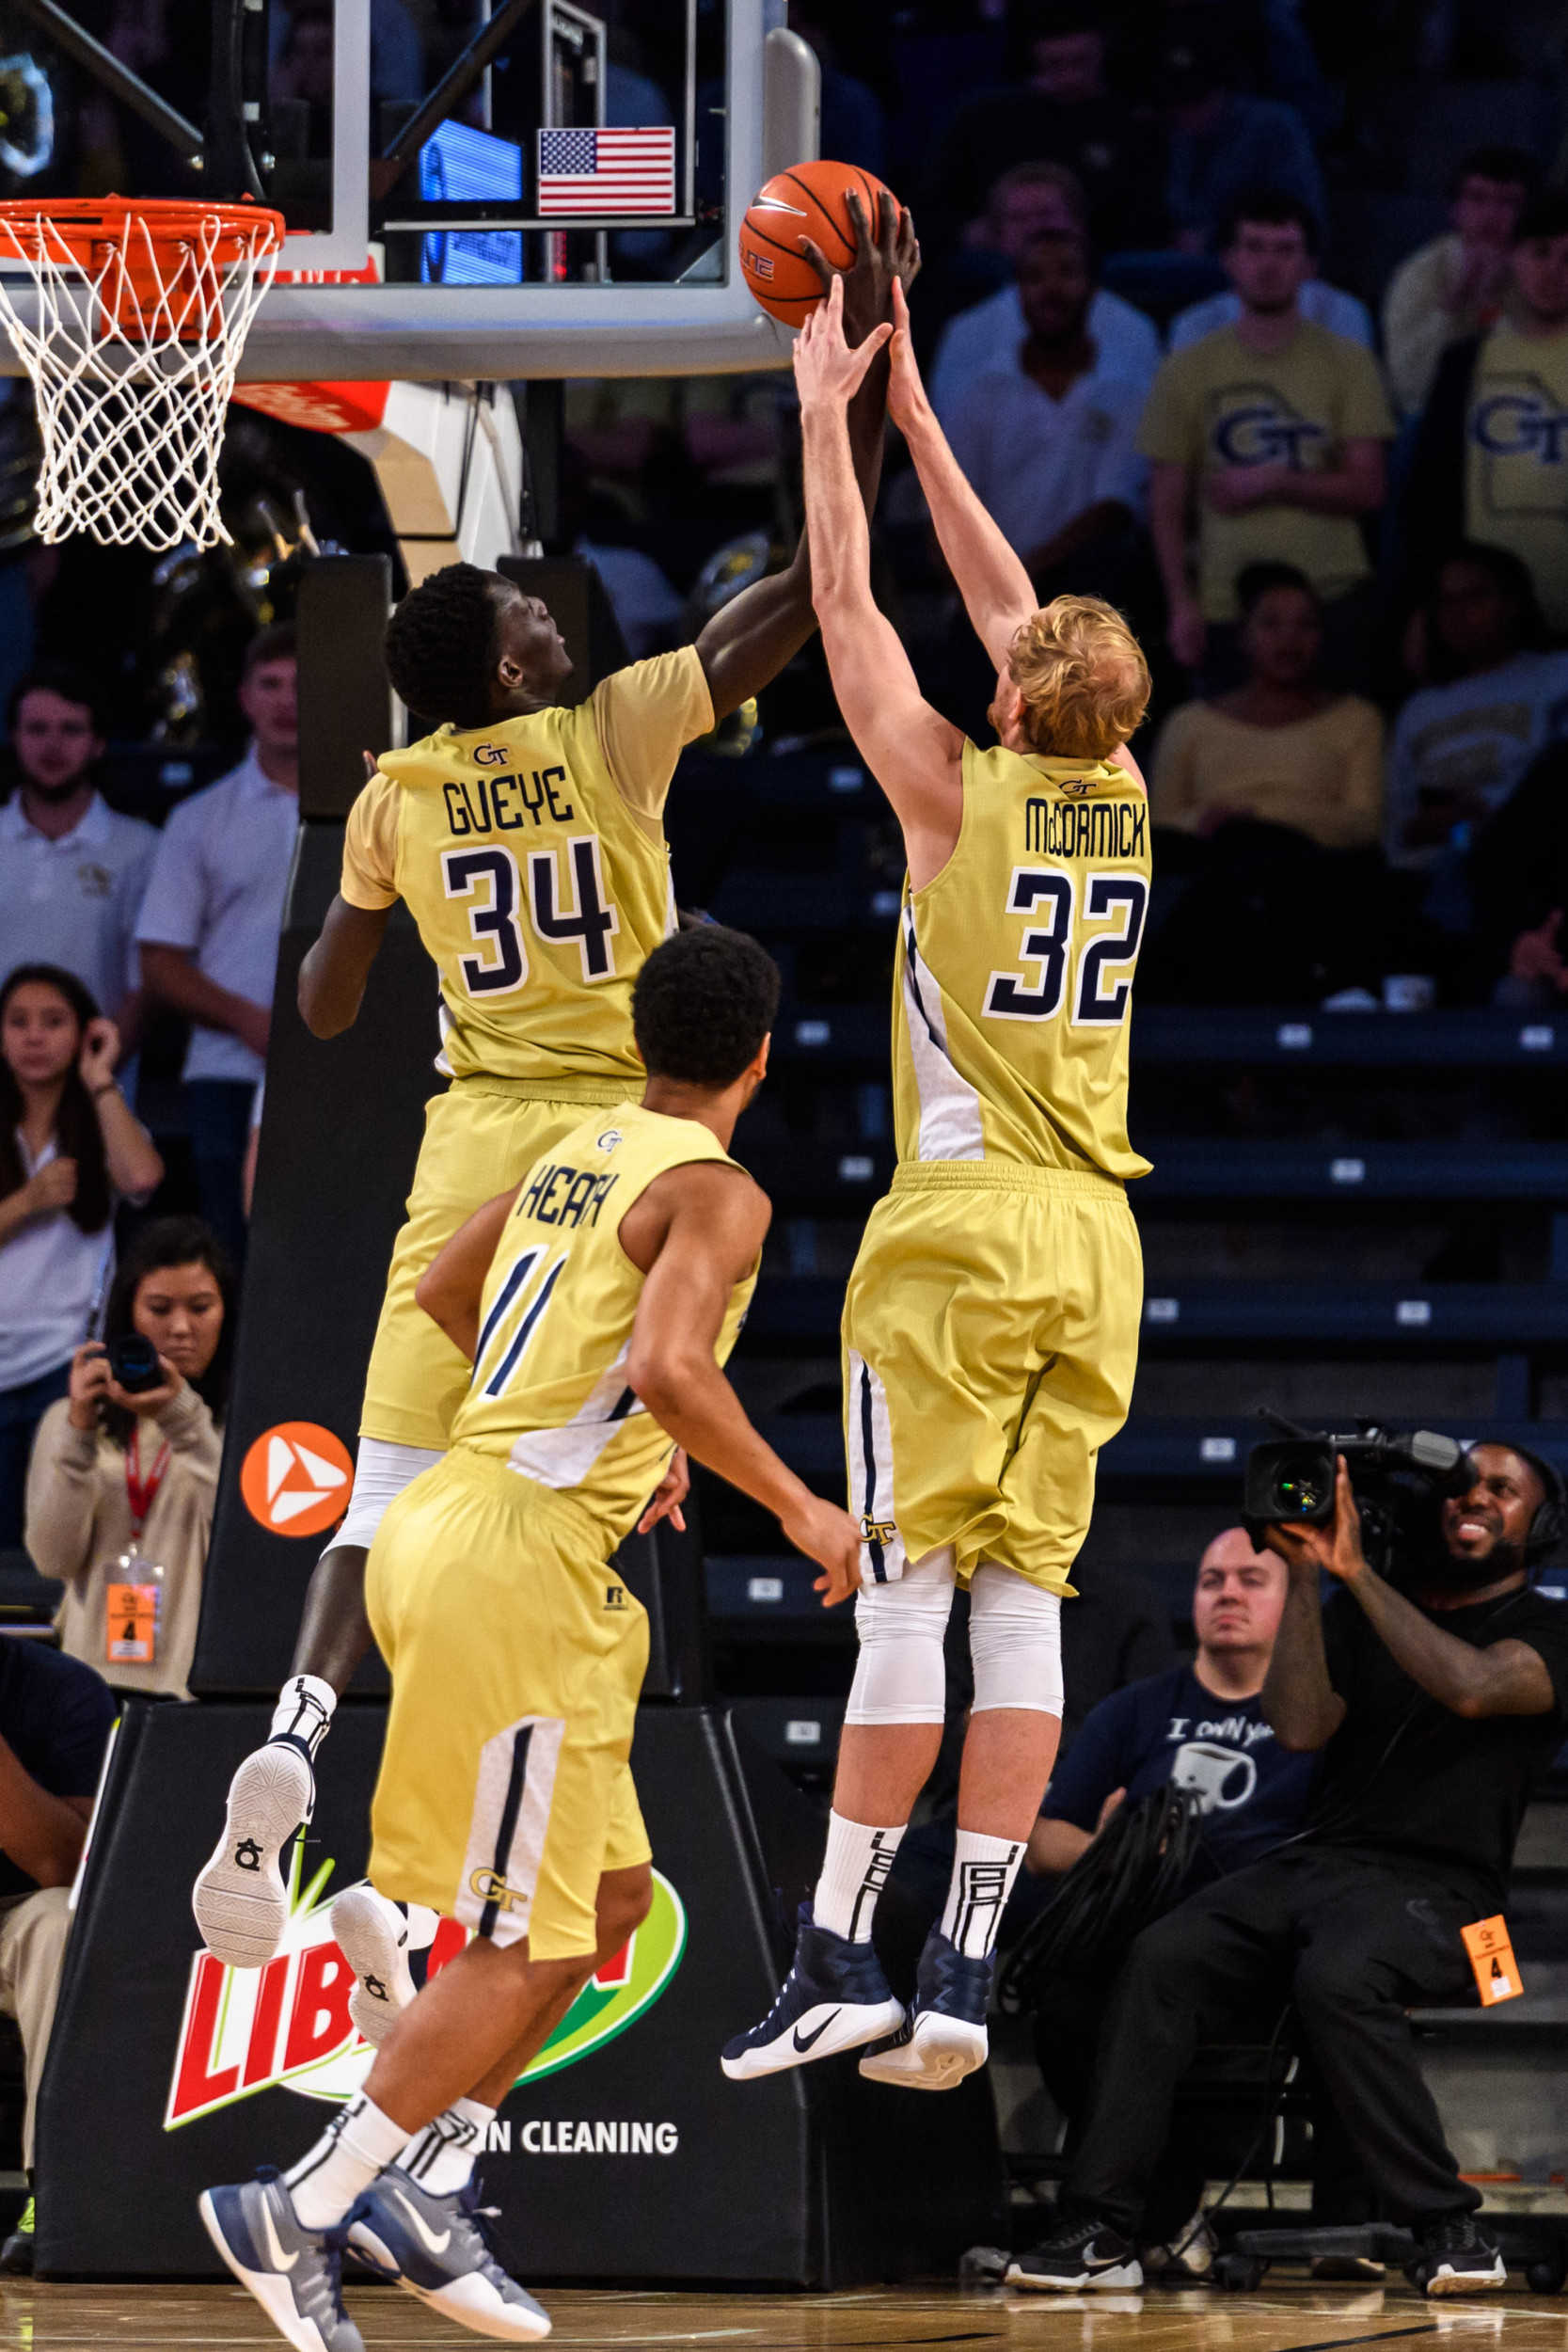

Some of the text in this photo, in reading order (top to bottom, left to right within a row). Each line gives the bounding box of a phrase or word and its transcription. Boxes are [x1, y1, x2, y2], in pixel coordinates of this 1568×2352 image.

[473, 743, 508, 765] GT
[443, 765, 574, 834] GUEYE
[1059, 779, 1097, 795] GT
[440, 834, 619, 997] 34
[981, 866, 1150, 1026] 32
[471, 1244, 570, 1403] 11
[859, 1513, 895, 1546] GT
[122, 1619, 137, 1641] 4
[1167, 1718, 1190, 1739] I
[469, 1867, 528, 1913] GT
[1491, 1957, 1503, 1979] 4
[521, 2121, 679, 2154] CLEANING
